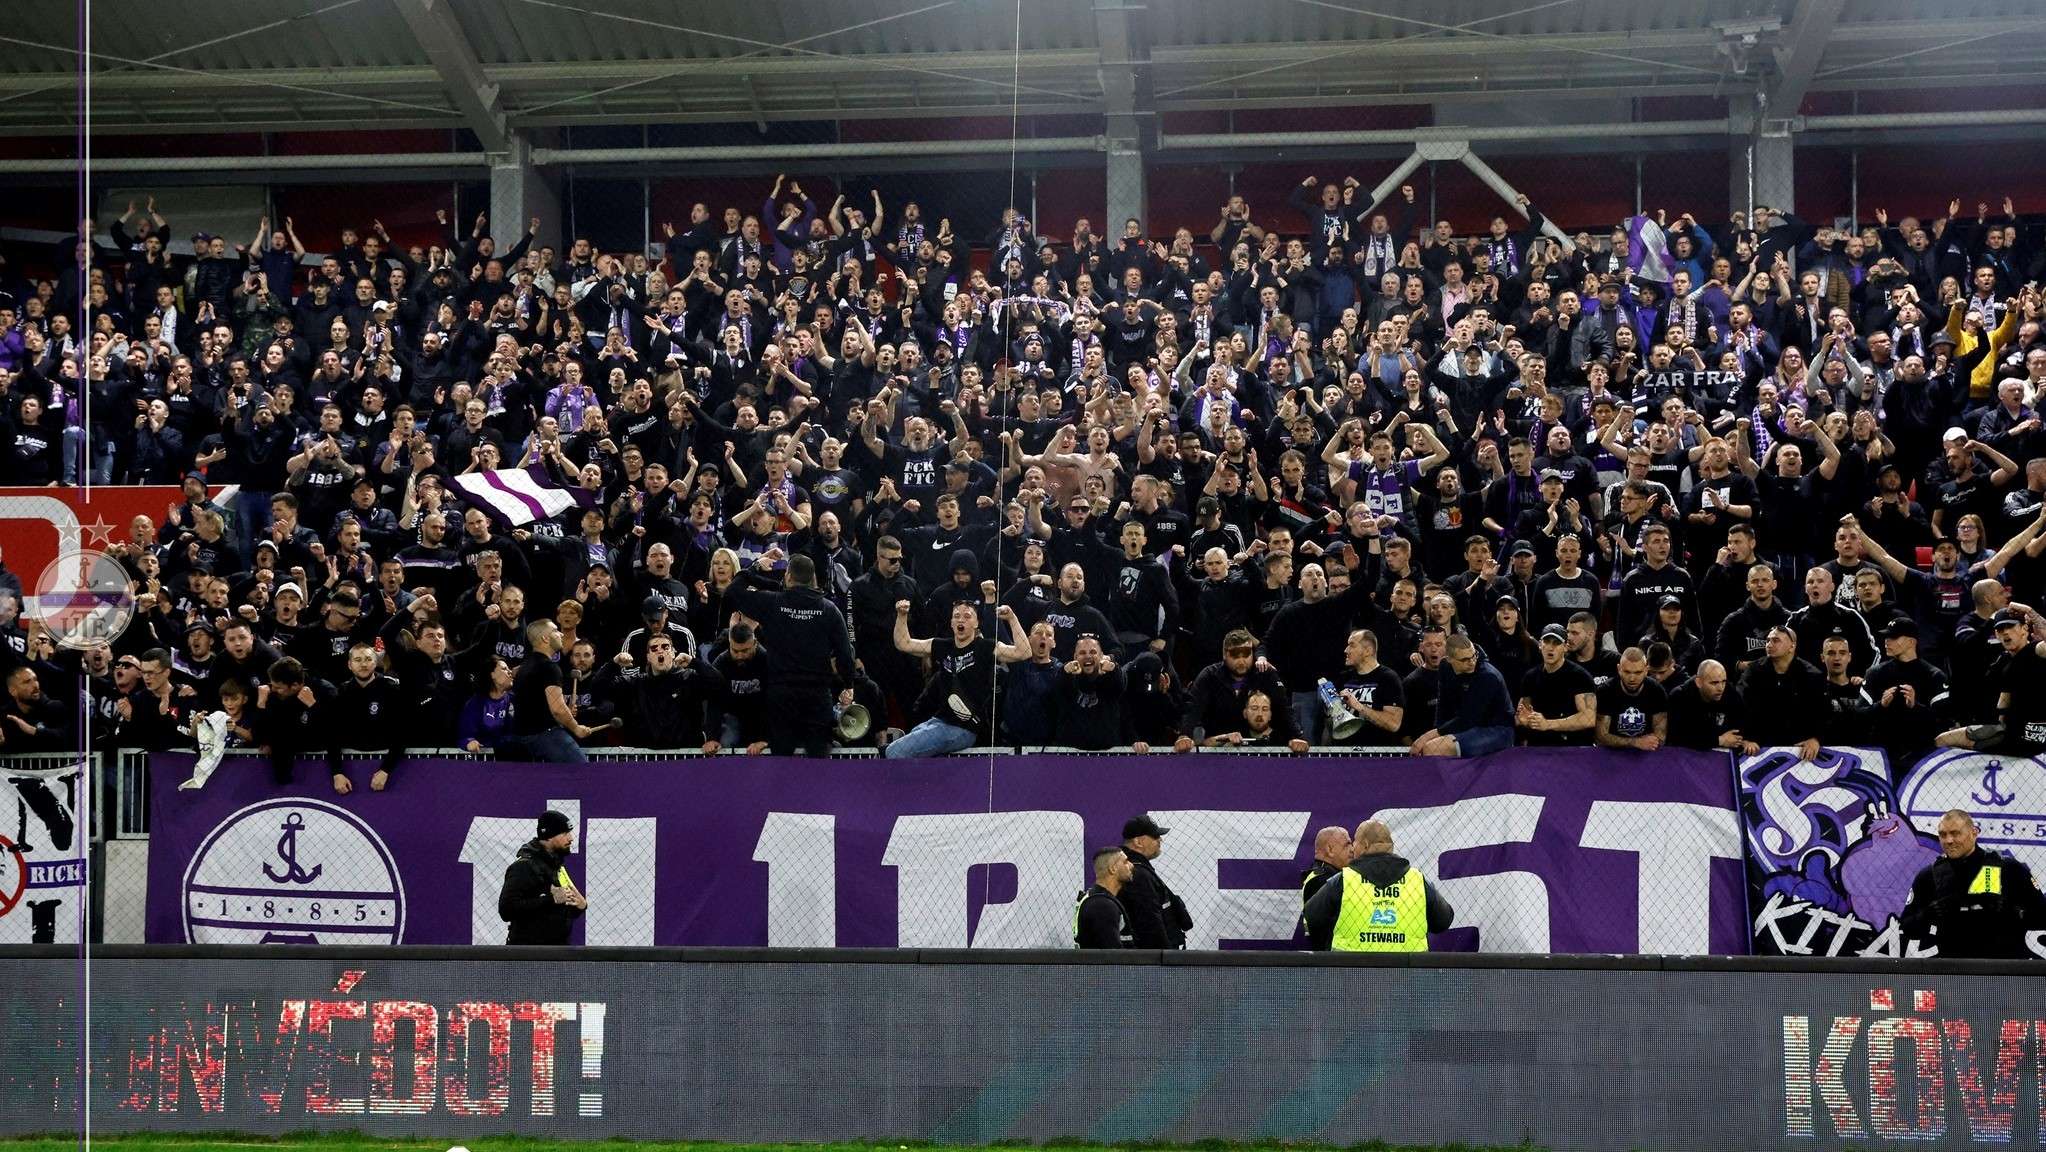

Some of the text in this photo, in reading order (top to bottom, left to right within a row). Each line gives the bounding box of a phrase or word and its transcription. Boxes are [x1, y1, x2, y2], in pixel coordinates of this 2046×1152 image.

[904, 460, 934, 472] FCK
[904, 472, 935, 485] FTC
[1635, 586, 1662, 595] NIKE
[1374, 886, 1400, 898] S146
[1360, 932, 1406, 943] STEWARD
[1782, 989, 2046, 1144] KÖV
